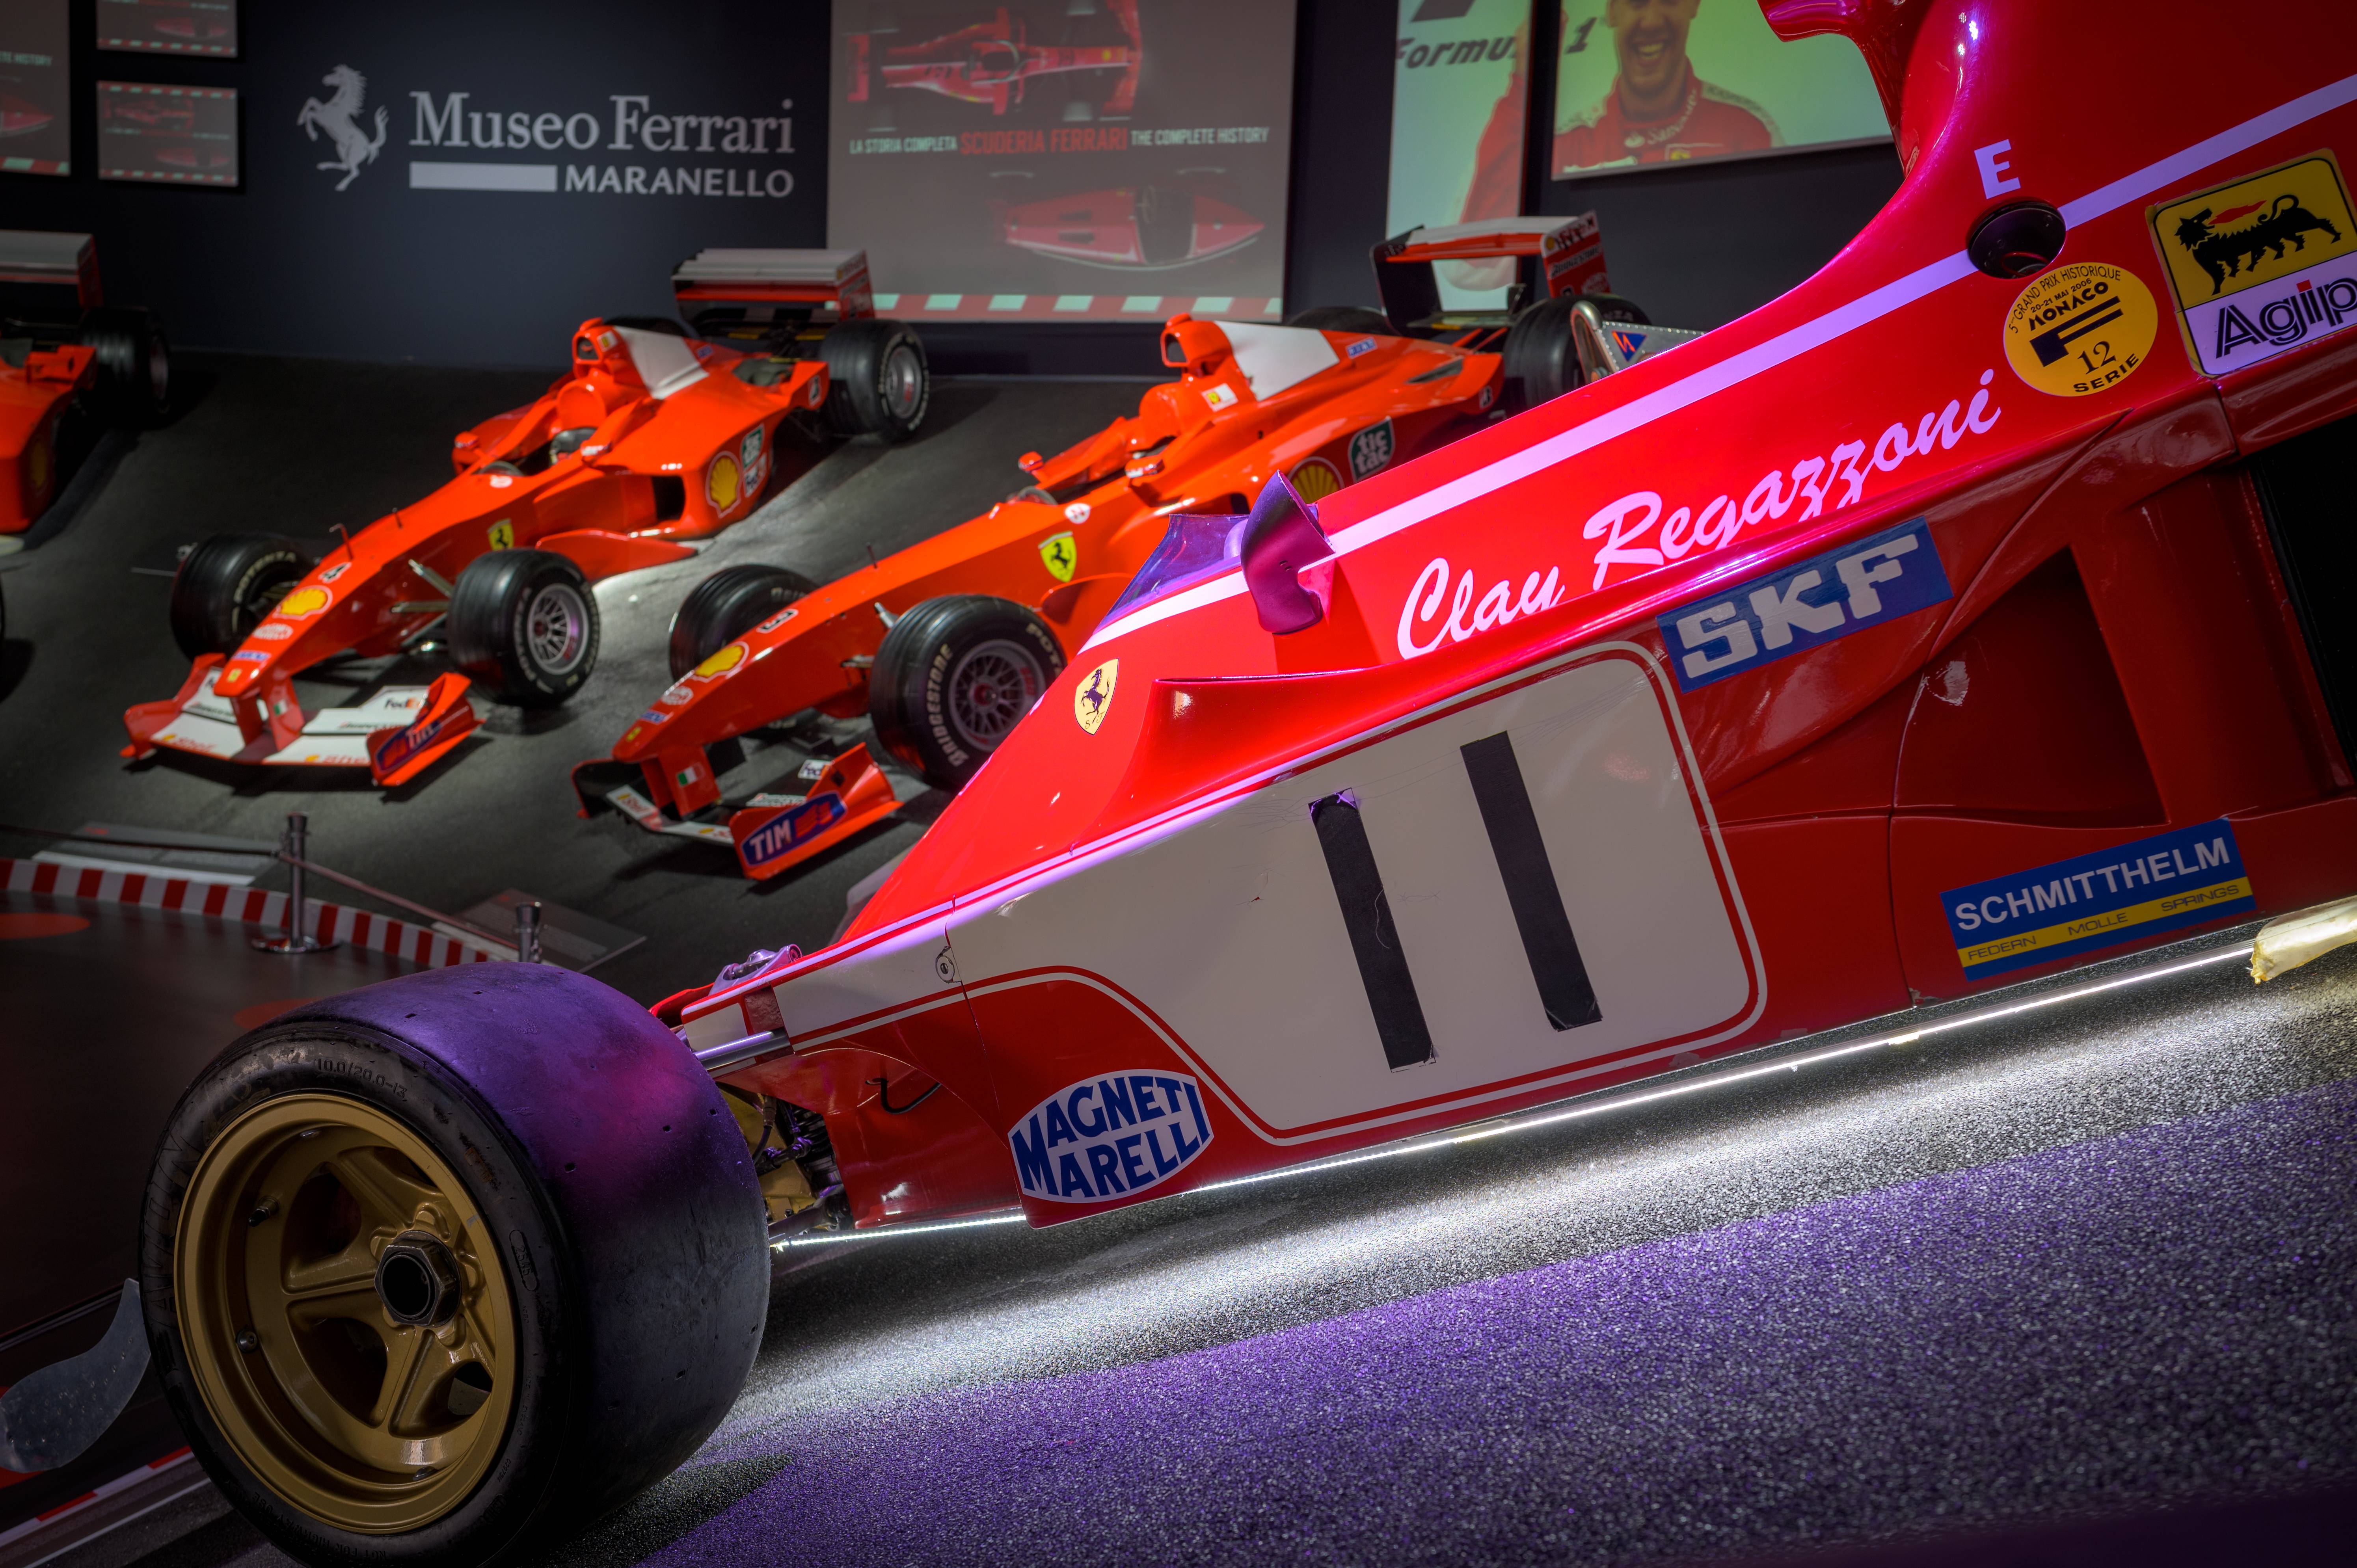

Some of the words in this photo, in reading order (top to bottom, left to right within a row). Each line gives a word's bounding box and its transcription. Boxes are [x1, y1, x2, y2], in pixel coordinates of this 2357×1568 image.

[1396, 35, 1517, 69] Formu
[410, 91, 599, 150] Museo
[607, 95, 795, 154] Ferrari
[850, 139, 864, 154] LA
[865, 138, 902, 153] STORIA
[903, 136, 957, 151] COMPLETA
[960, 130, 1045, 154] SCUDERIA
[1050, 127, 1128, 152] FERRARI
[1131, 130, 1152, 145] THE
[1154, 128, 1215, 145] COMPLETE
[1217, 126, 1270, 143] HISTORY
[565, 164, 794, 197] MARANELLO
[1974, 139, 2021, 199] E
[2013, 287, 2040, 320] GRAND
[2040, 273, 2060, 291] PRIX
[2060, 266, 2121, 281] HISTORIQUE
[2029, 282, 2109, 331] MONACO
[2031, 298, 2053, 313] 20-21
[2054, 289, 2069, 301] MAI
[2070, 278, 2092, 292] 2006
[2216, 277, 2357, 359] Agip
[2073, 353, 2139, 392] SERIE
[2077, 340, 2117, 375] 12
[1397, 558, 1565, 660] Clay
[1583, 369, 2001, 591] Regazzoni
[1676, 534, 1919, 679] SKF
[926, 643, 969, 767] BRIDGESTONE
[1085, 720, 1090, 729] S
[749, 819, 792, 861] TIM
[1308, 730, 1603, 1073] 11
[1955, 837, 2230, 931] SCHMITTHELM
[1968, 936, 2037, 960] FEDERN
[2068, 912, 2128, 936] MOLLE
[2161, 885, 2239, 911] SPRINGS
[1012, 1076, 1210, 1192] MAGNETI
[1012, 1090, 1210, 1198] MARELLI
[251, 1492, 274, 1514] USE
[365, 1549, 386, 1561] NOT
